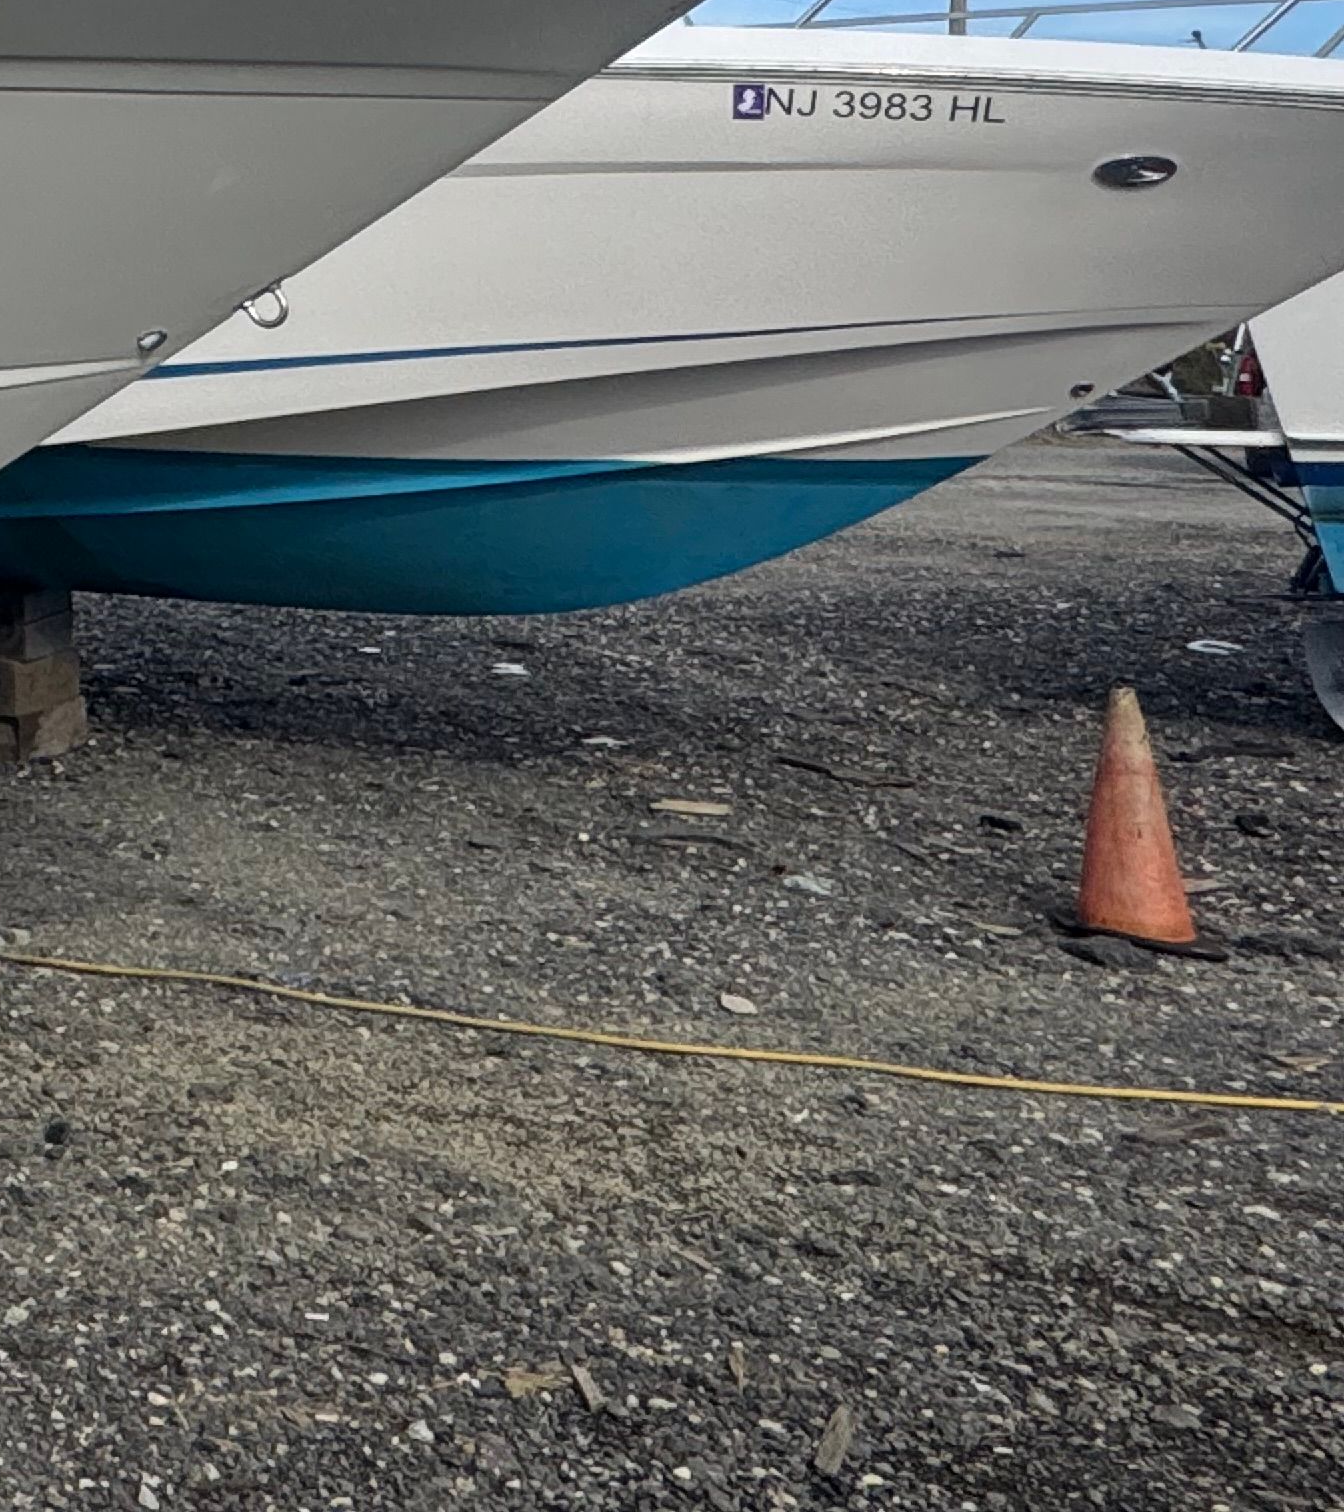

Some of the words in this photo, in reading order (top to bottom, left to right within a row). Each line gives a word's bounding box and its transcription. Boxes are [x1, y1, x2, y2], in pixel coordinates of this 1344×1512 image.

[765, 87, 817, 116] NJ
[832, 90, 933, 121] 3983
[948, 95, 1006, 123] HL
